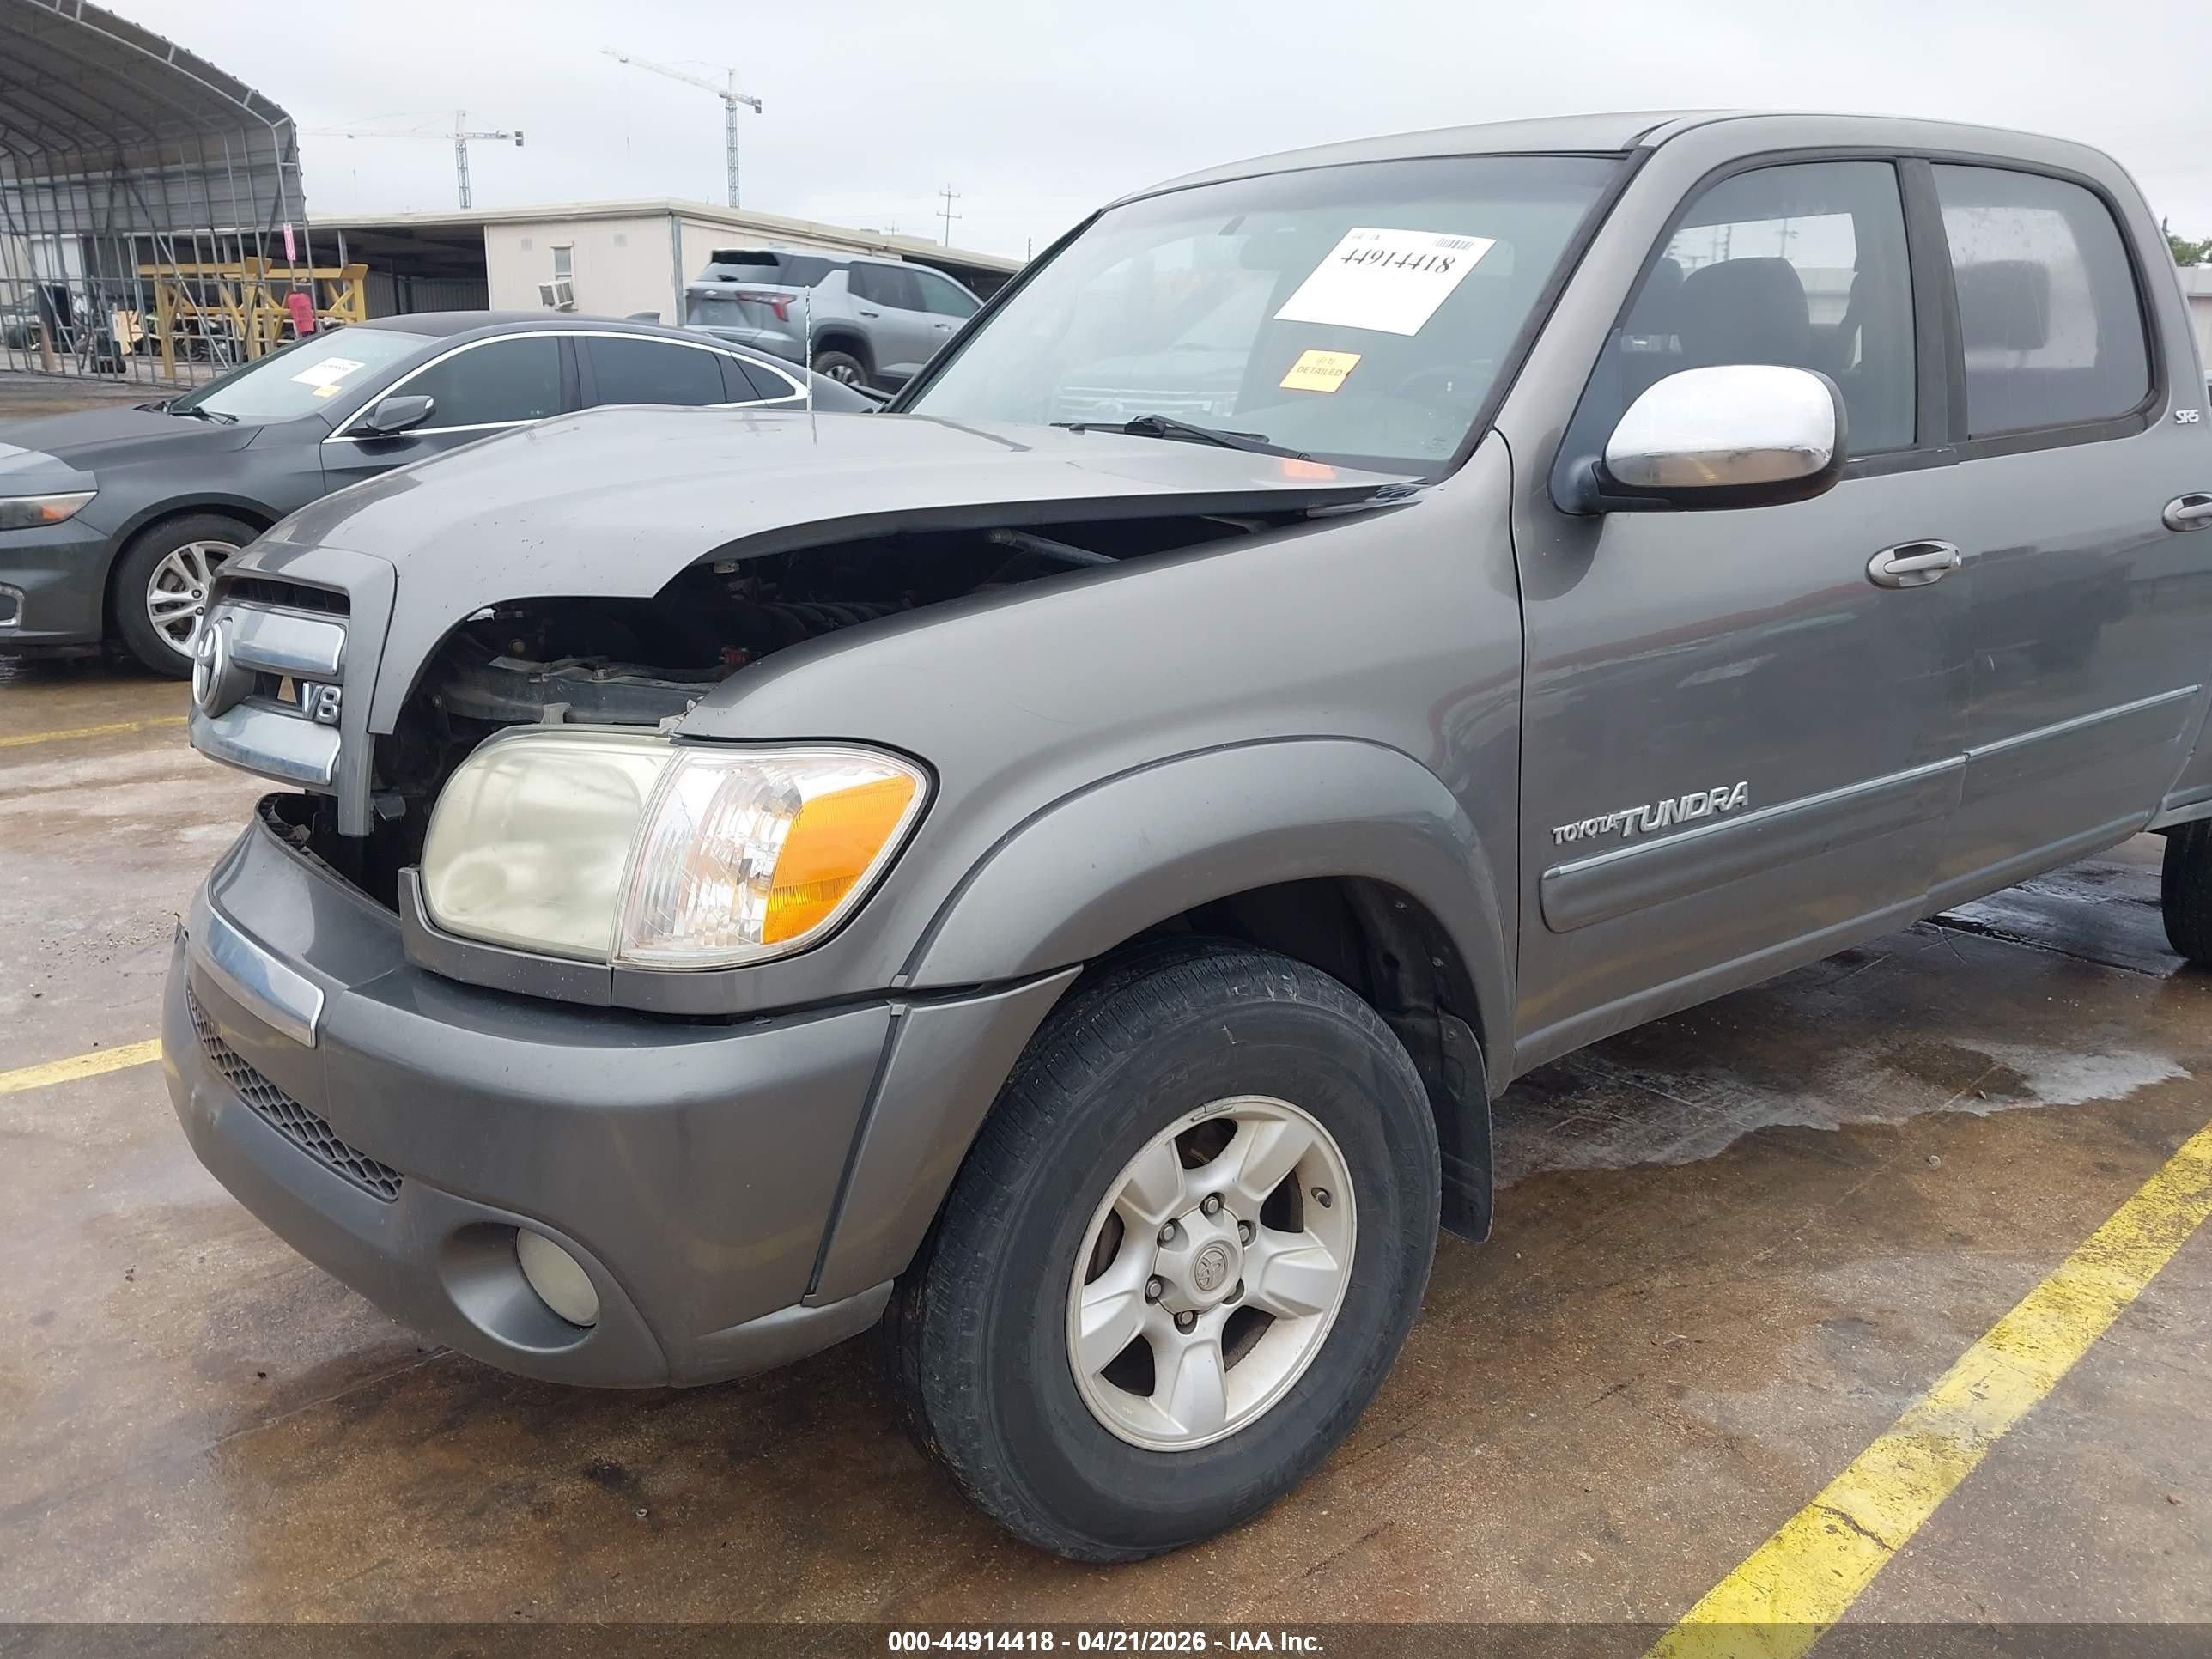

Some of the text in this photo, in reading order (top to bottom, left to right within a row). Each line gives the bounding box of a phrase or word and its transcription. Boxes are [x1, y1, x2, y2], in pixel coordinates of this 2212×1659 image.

[1340, 247, 1456, 274] 44914418
[2174, 408, 2199, 425] SR5
[301, 682, 342, 722] V8
[1552, 781, 1749, 845] TOYOTA TUNDRA
